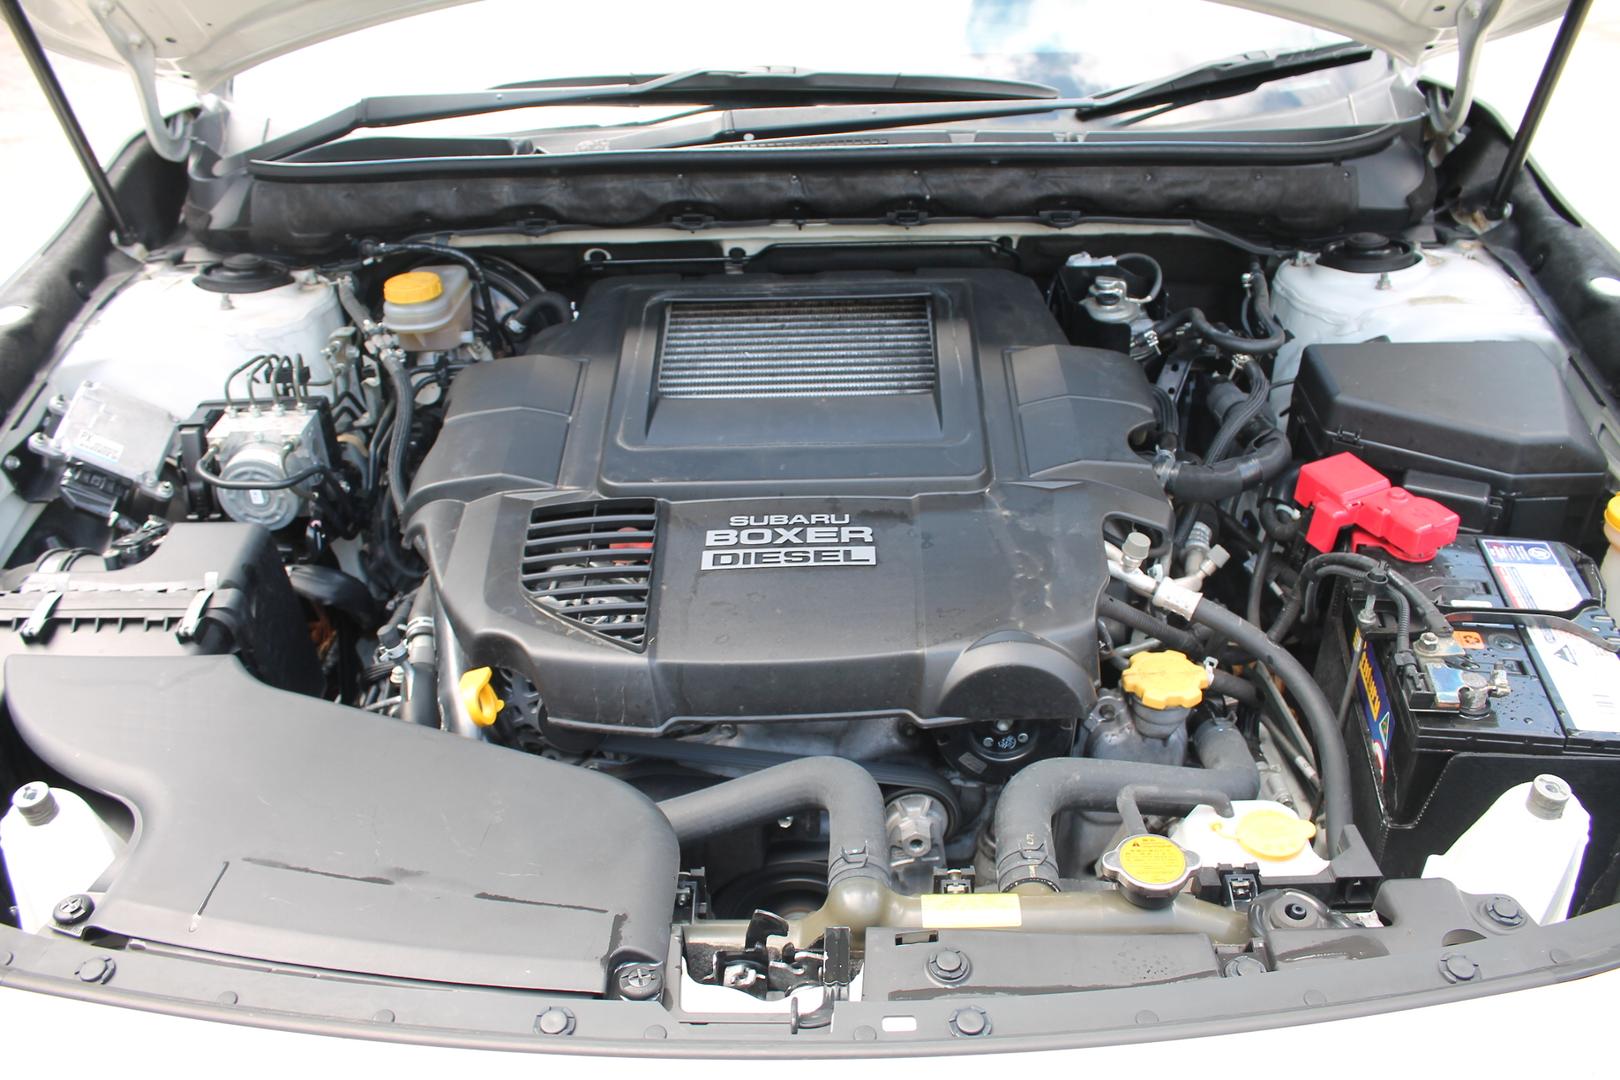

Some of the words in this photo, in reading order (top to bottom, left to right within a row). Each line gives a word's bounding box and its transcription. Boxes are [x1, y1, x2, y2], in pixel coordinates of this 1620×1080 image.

[729, 513, 850, 527] SUBARU
[705, 526, 873, 546] BOXER
[712, 549, 871, 567] DIESEL
